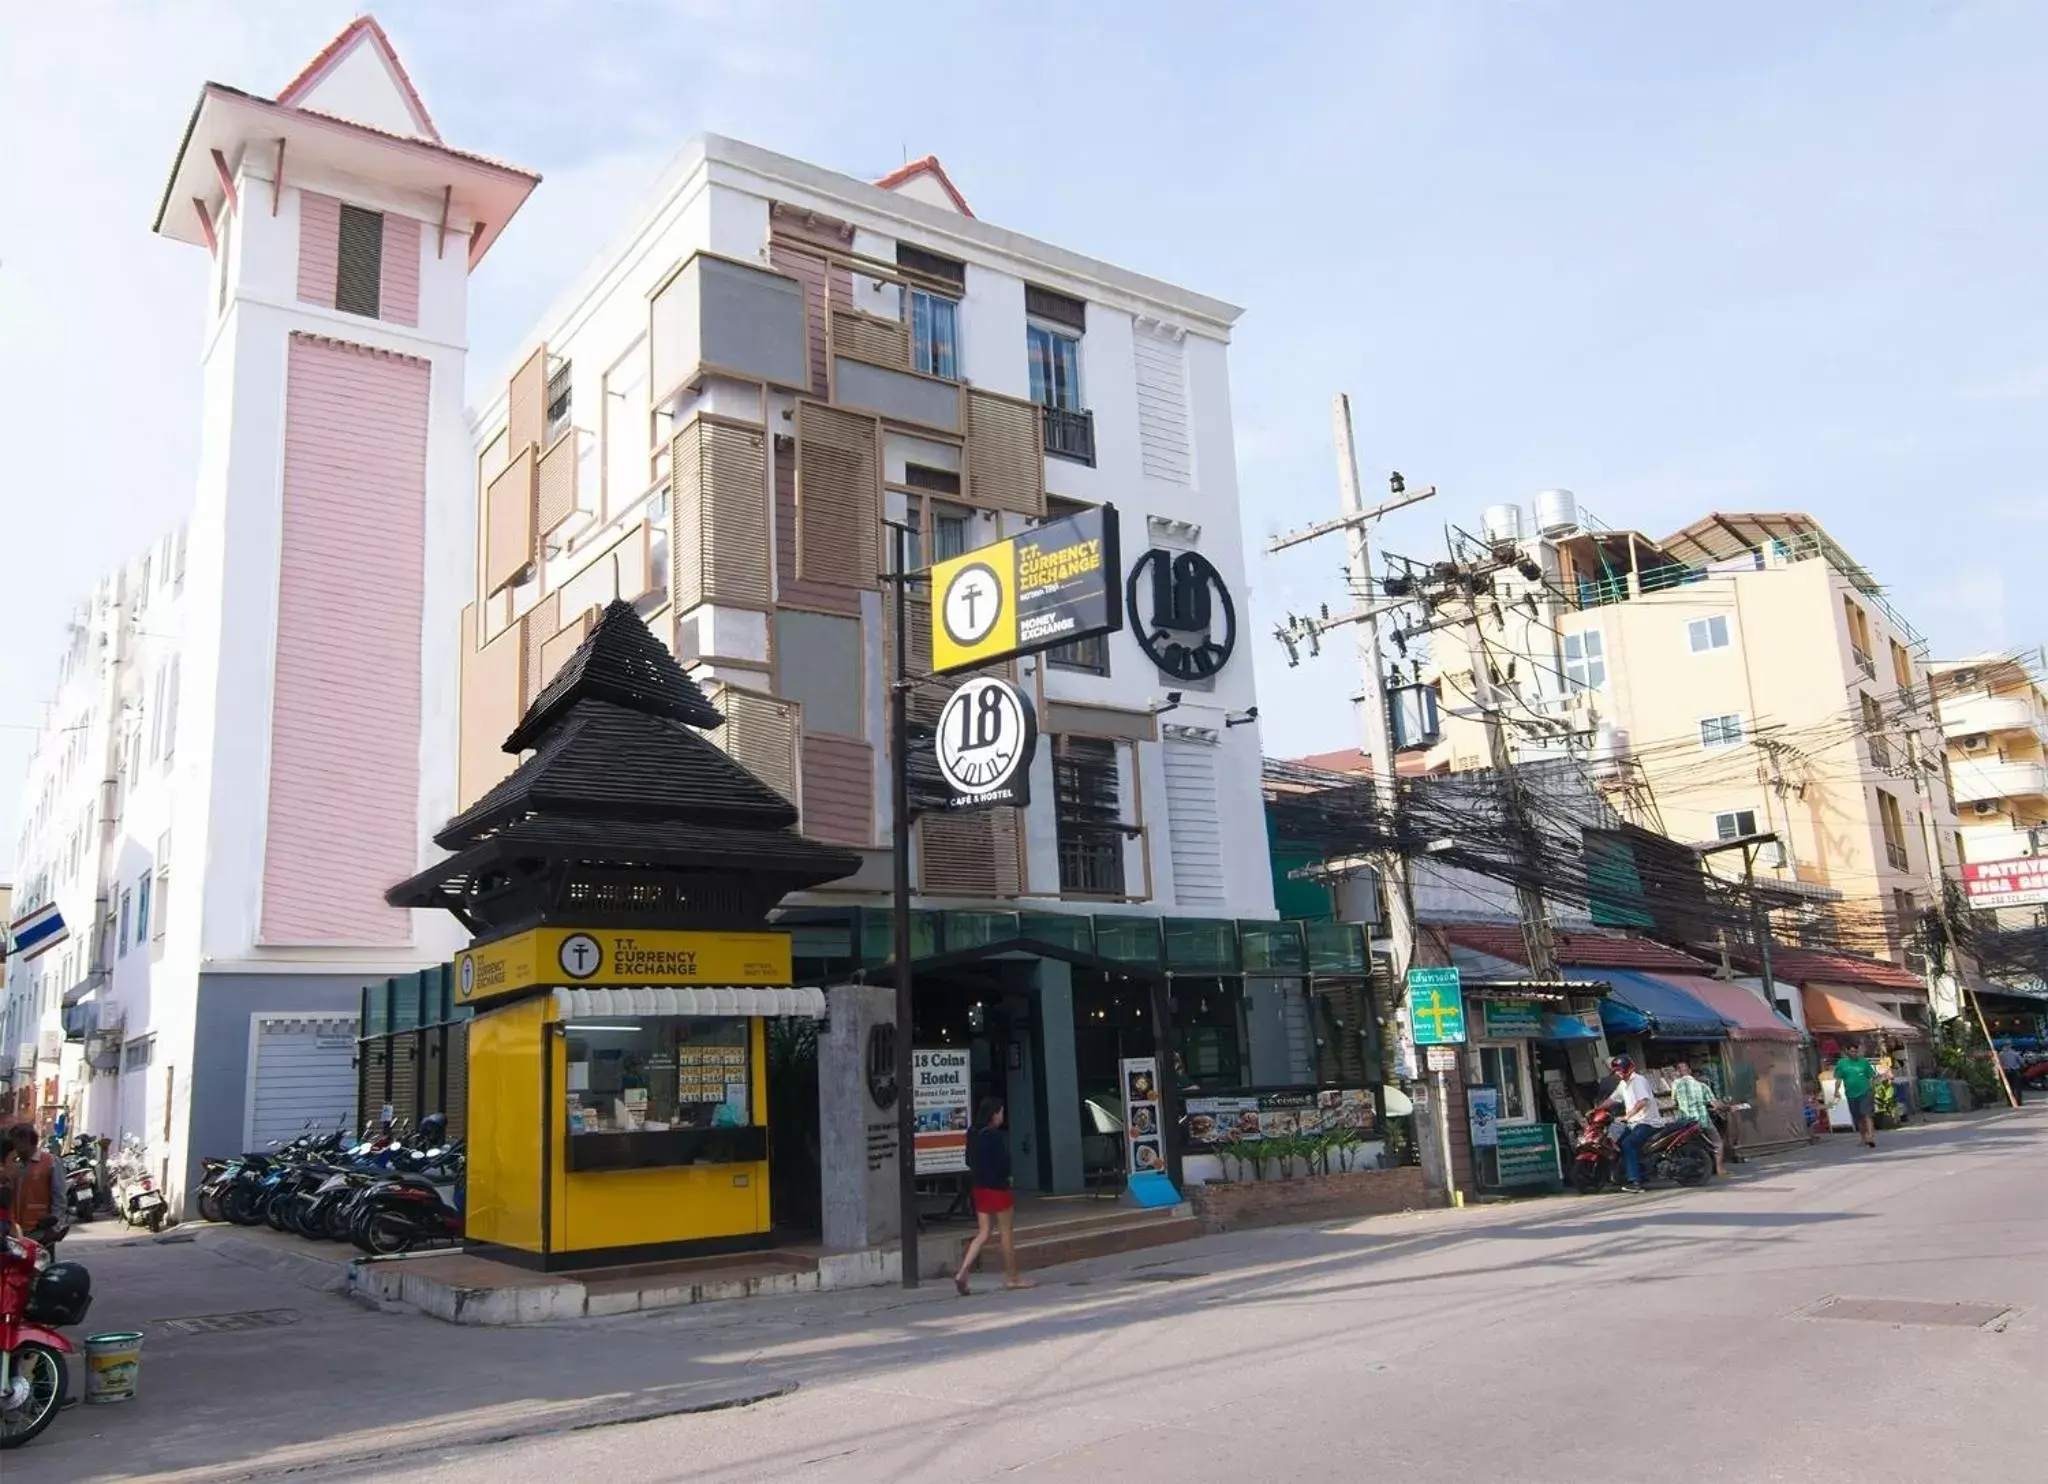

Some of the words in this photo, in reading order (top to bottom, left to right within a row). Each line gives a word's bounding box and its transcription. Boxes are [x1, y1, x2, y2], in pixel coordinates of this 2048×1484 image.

[1020, 539, 1098, 576] CURRENCY
[1150, 549, 1211, 632] 18
[1020, 612, 1056, 631] MONEY
[1021, 617, 1075, 641] EXCHANGE
[957, 685, 1002, 753] 18
[981, 789, 1014, 802] HOSTEL
[614, 938, 637, 950] T.T.
[614, 951, 697, 963] CURRENCY
[614, 963, 697, 975] EXCHANGE
[915, 1054, 928, 1067] 18
[931, 1053, 965, 1067] Coins
[921, 1071, 959, 1085] Hostel
